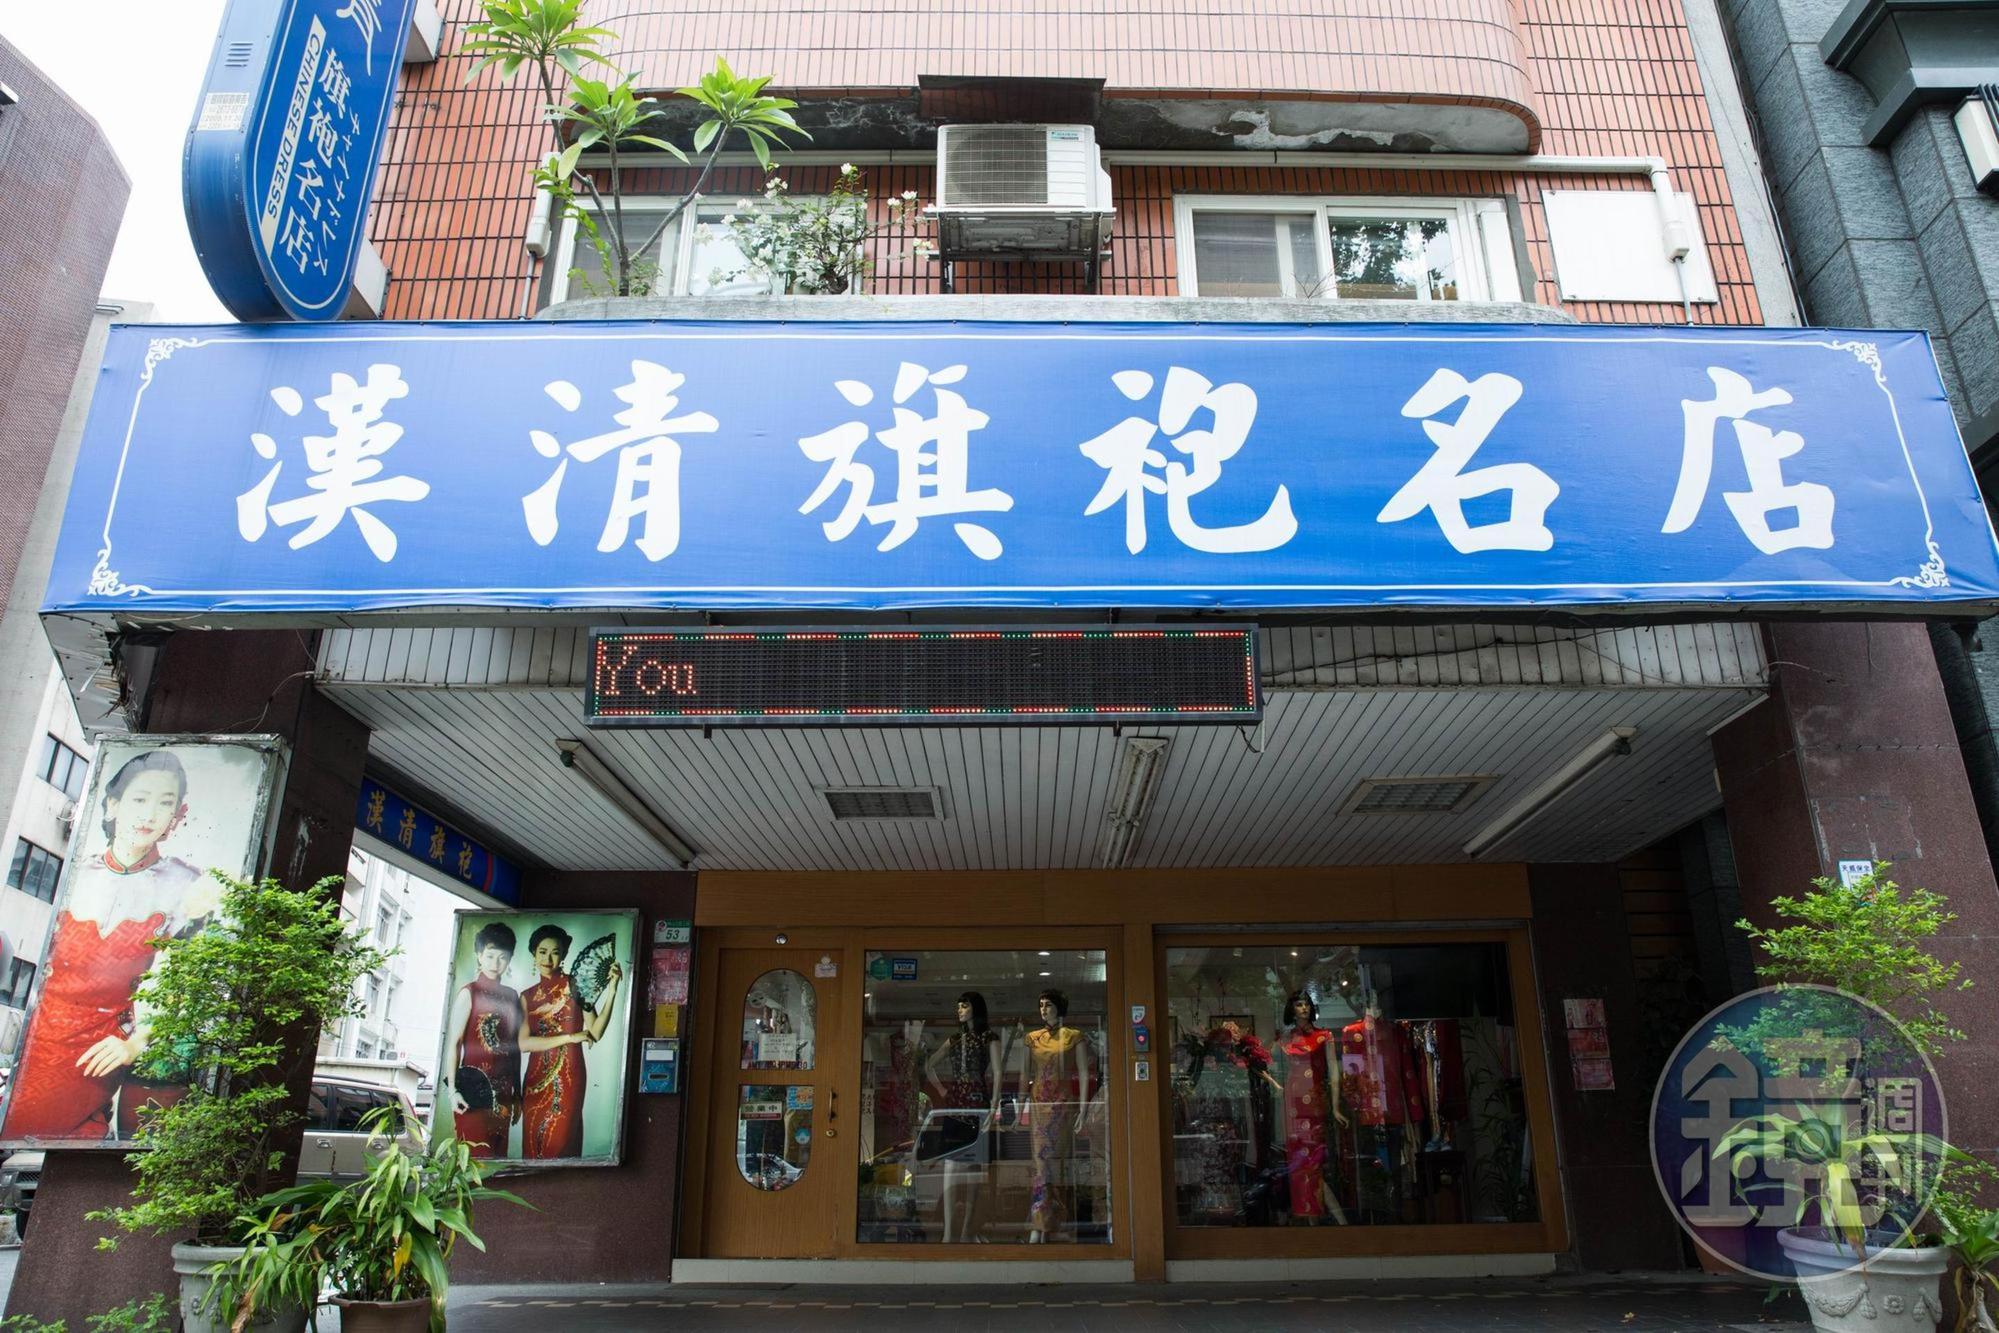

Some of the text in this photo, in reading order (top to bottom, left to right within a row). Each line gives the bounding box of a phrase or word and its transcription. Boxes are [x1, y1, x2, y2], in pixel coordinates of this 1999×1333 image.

[267, 33, 321, 219] CHINESE DRESS
[280, 48, 351, 274] 旗袍名店
[236, 359, 1836, 563] 漢清旗袍名店
[598, 645, 698, 696] You
[367, 790, 473, 880] 漢清旗袍
[666, 929, 680, 940] 53
